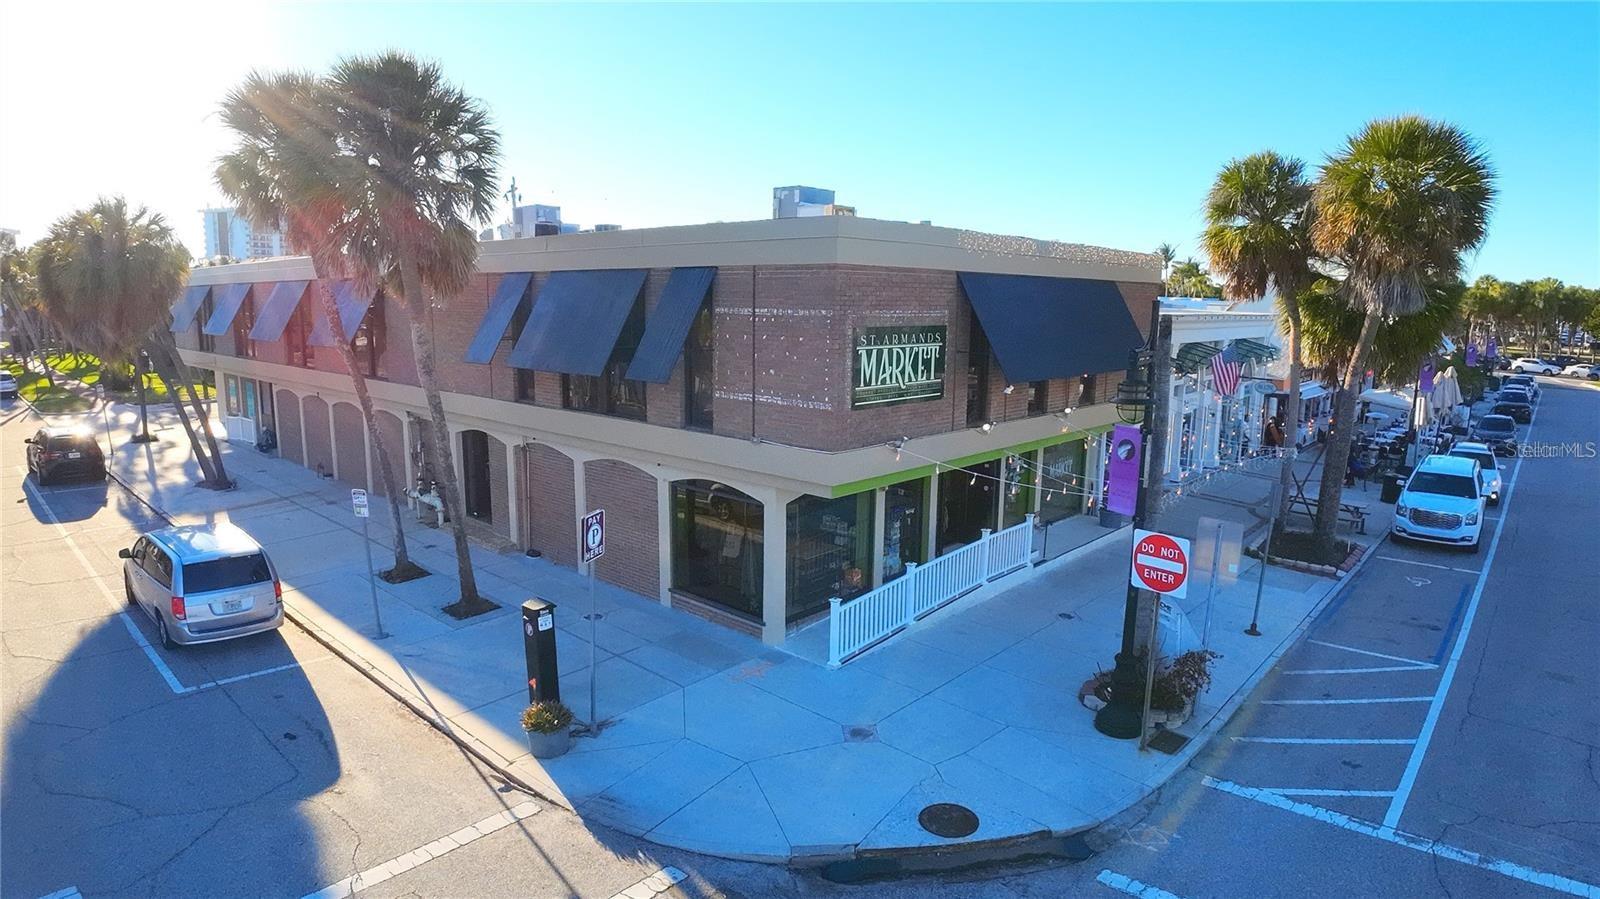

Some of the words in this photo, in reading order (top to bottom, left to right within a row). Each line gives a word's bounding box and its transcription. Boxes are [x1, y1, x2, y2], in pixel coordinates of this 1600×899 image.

[883, 332, 941, 345] ARMANDS
[858, 346, 939, 389] MARKET
[588, 513, 601, 527] PAY
[592, 528, 599, 545] P
[586, 544, 604, 560] HERE
[1141, 542, 1155, 553] DO
[1160, 546, 1180, 559] NOT
[1143, 569, 1175, 584] ENTER
